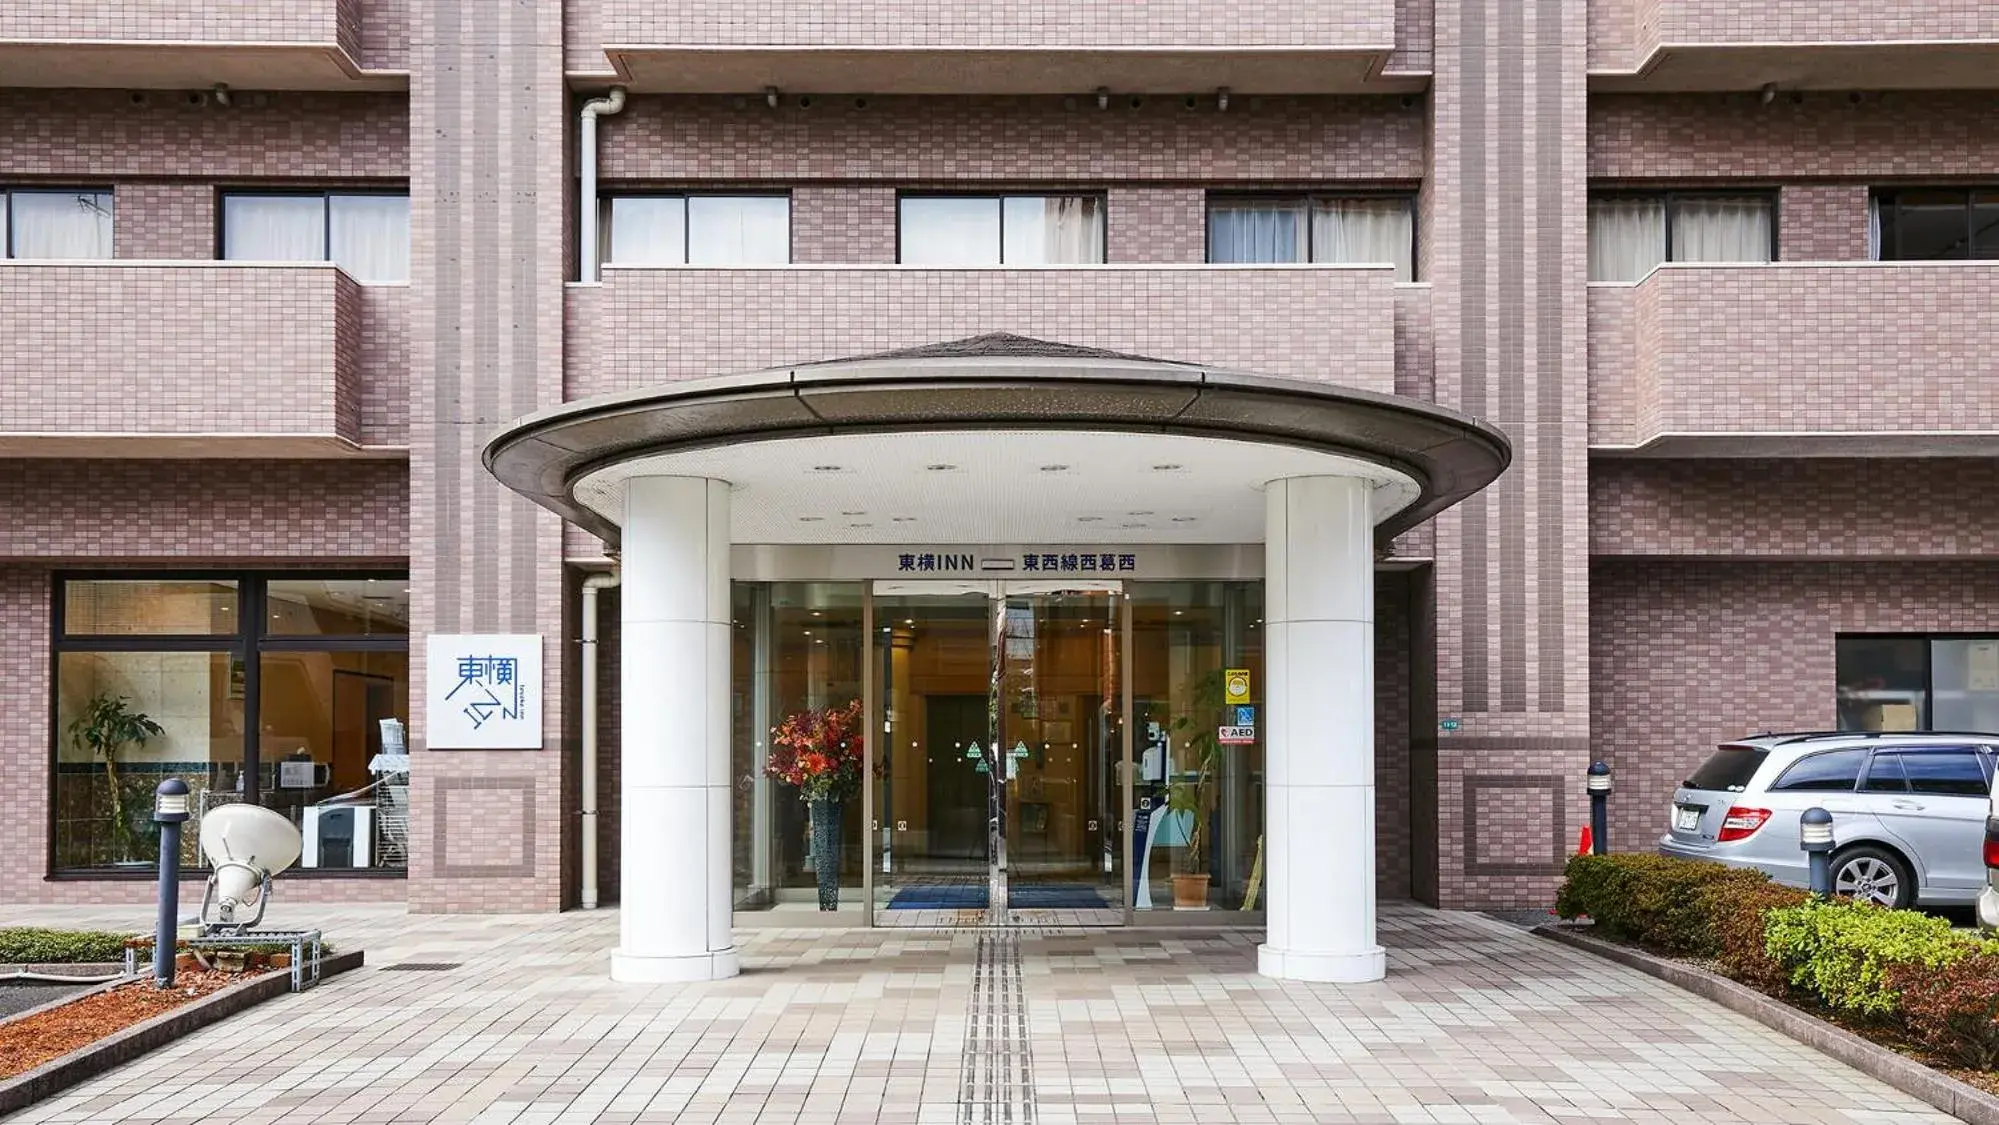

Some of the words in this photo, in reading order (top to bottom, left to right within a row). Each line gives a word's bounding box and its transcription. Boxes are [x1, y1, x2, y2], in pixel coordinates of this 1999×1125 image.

[898, 553, 974, 572] 東横INN
[1022, 553, 1136, 572] 東西線西葛西
[1230, 728, 1253, 737] AED
